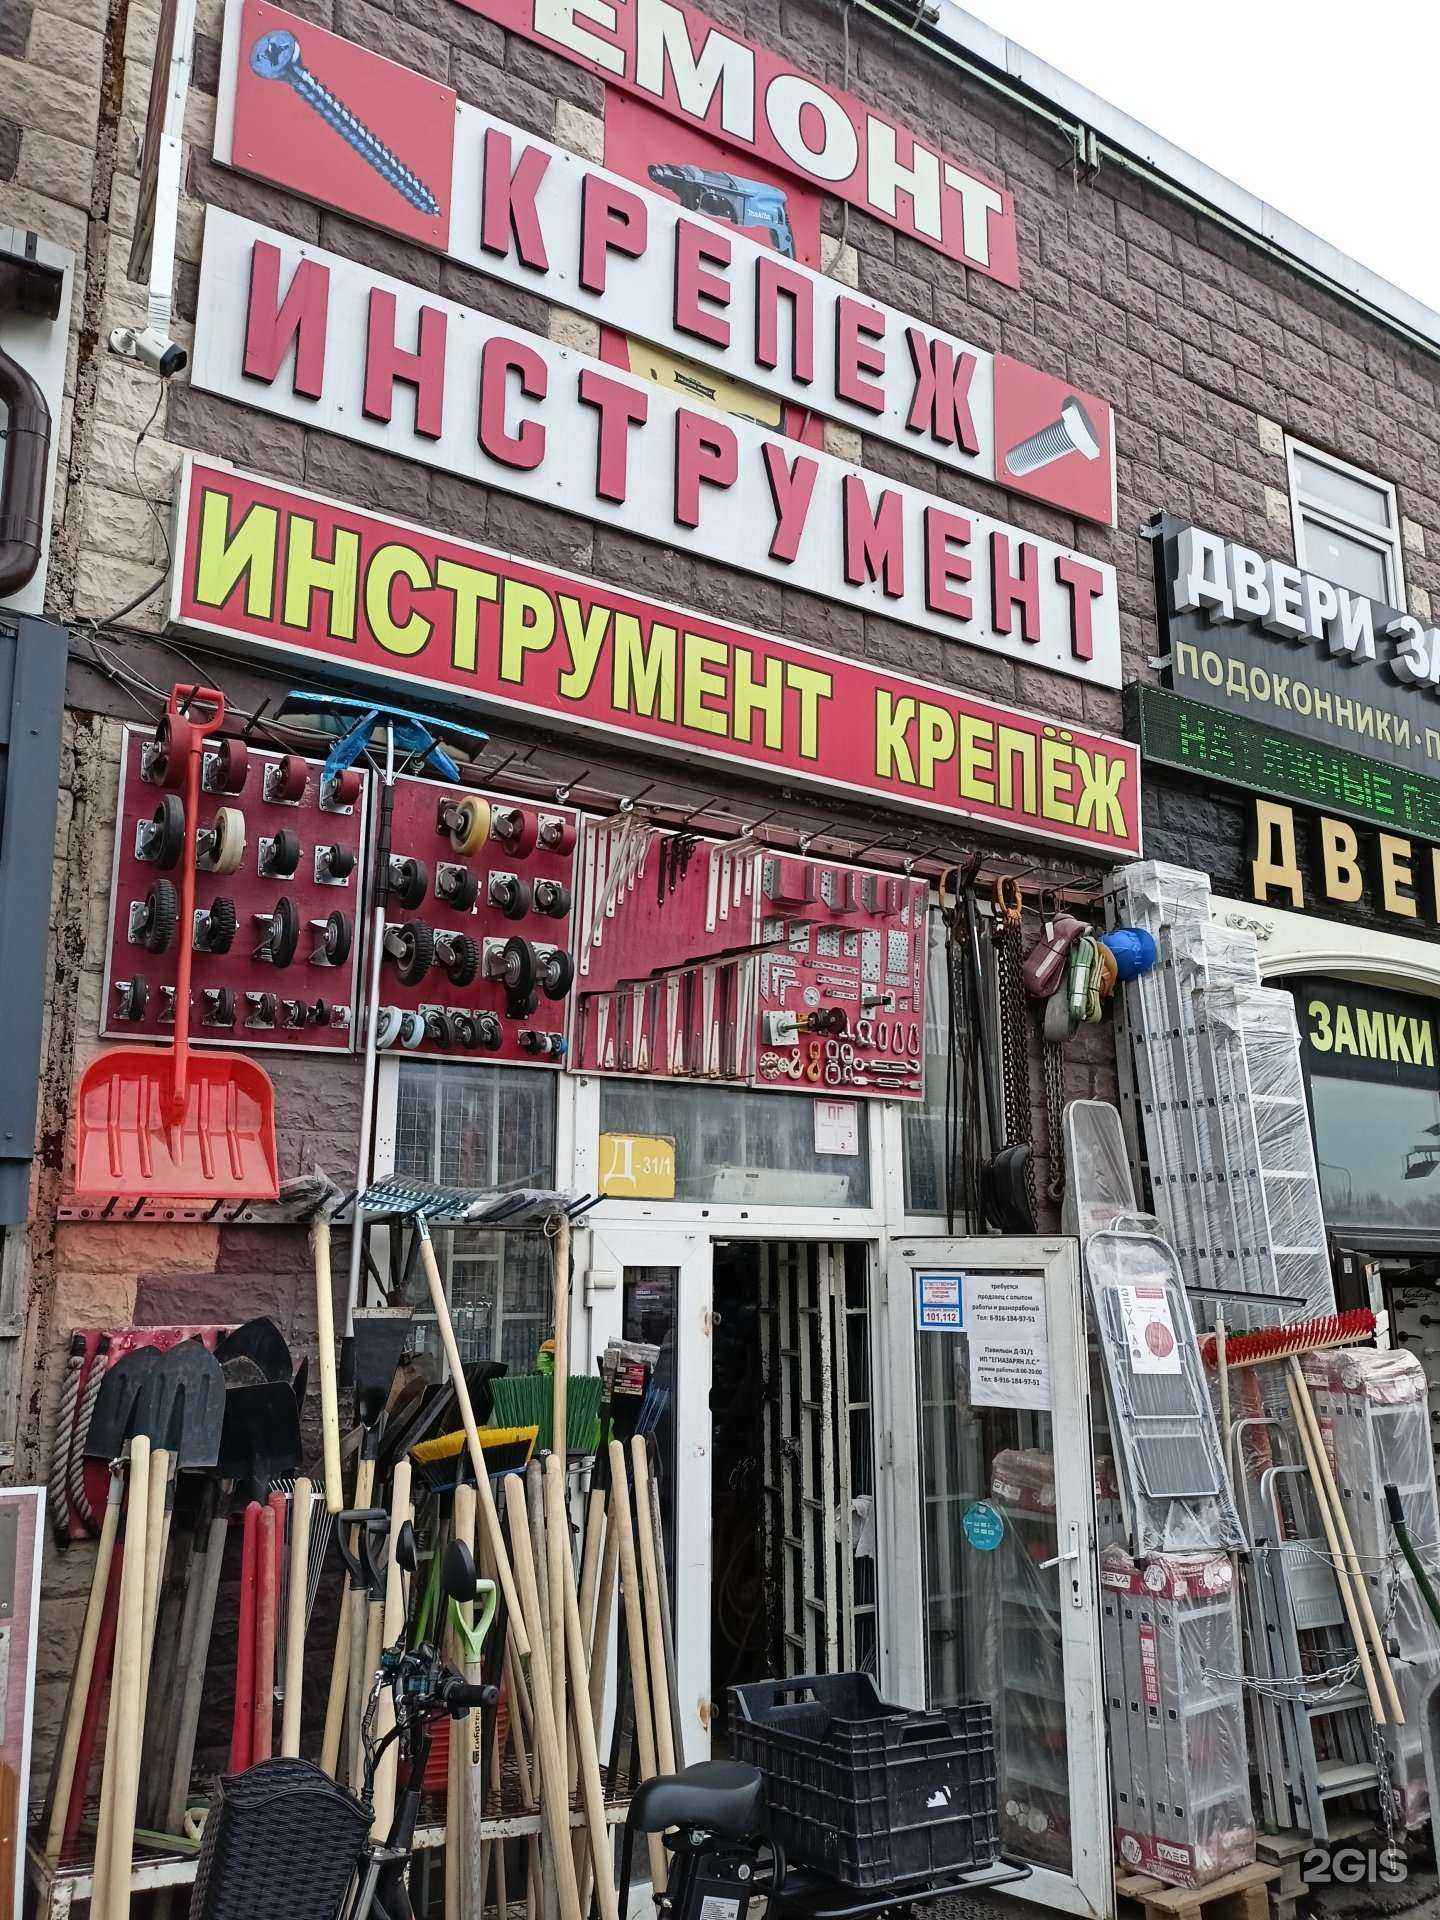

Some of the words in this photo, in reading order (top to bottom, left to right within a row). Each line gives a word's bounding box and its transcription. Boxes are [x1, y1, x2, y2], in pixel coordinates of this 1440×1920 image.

[482, 128, 978, 456] КРЕПЕЖ
[242, 239, 1103, 661] ИНСТРУМЕНТ
[1173, 526, 1377, 664] ДВЕРИ
[196, 489, 833, 760] ИНСТРУМЕНТ
[875, 688, 1127, 838] КРЕПЁЖ
[1175, 641, 1411, 749] ПОДОКОННИКИ
[1253, 799, 1440, 924] ДВЕ
[1309, 1001, 1434, 1067] ЗАМКИ
[926, 1312, 956, 1322] 101,112
[991, 1283, 1019, 1291] требуется
